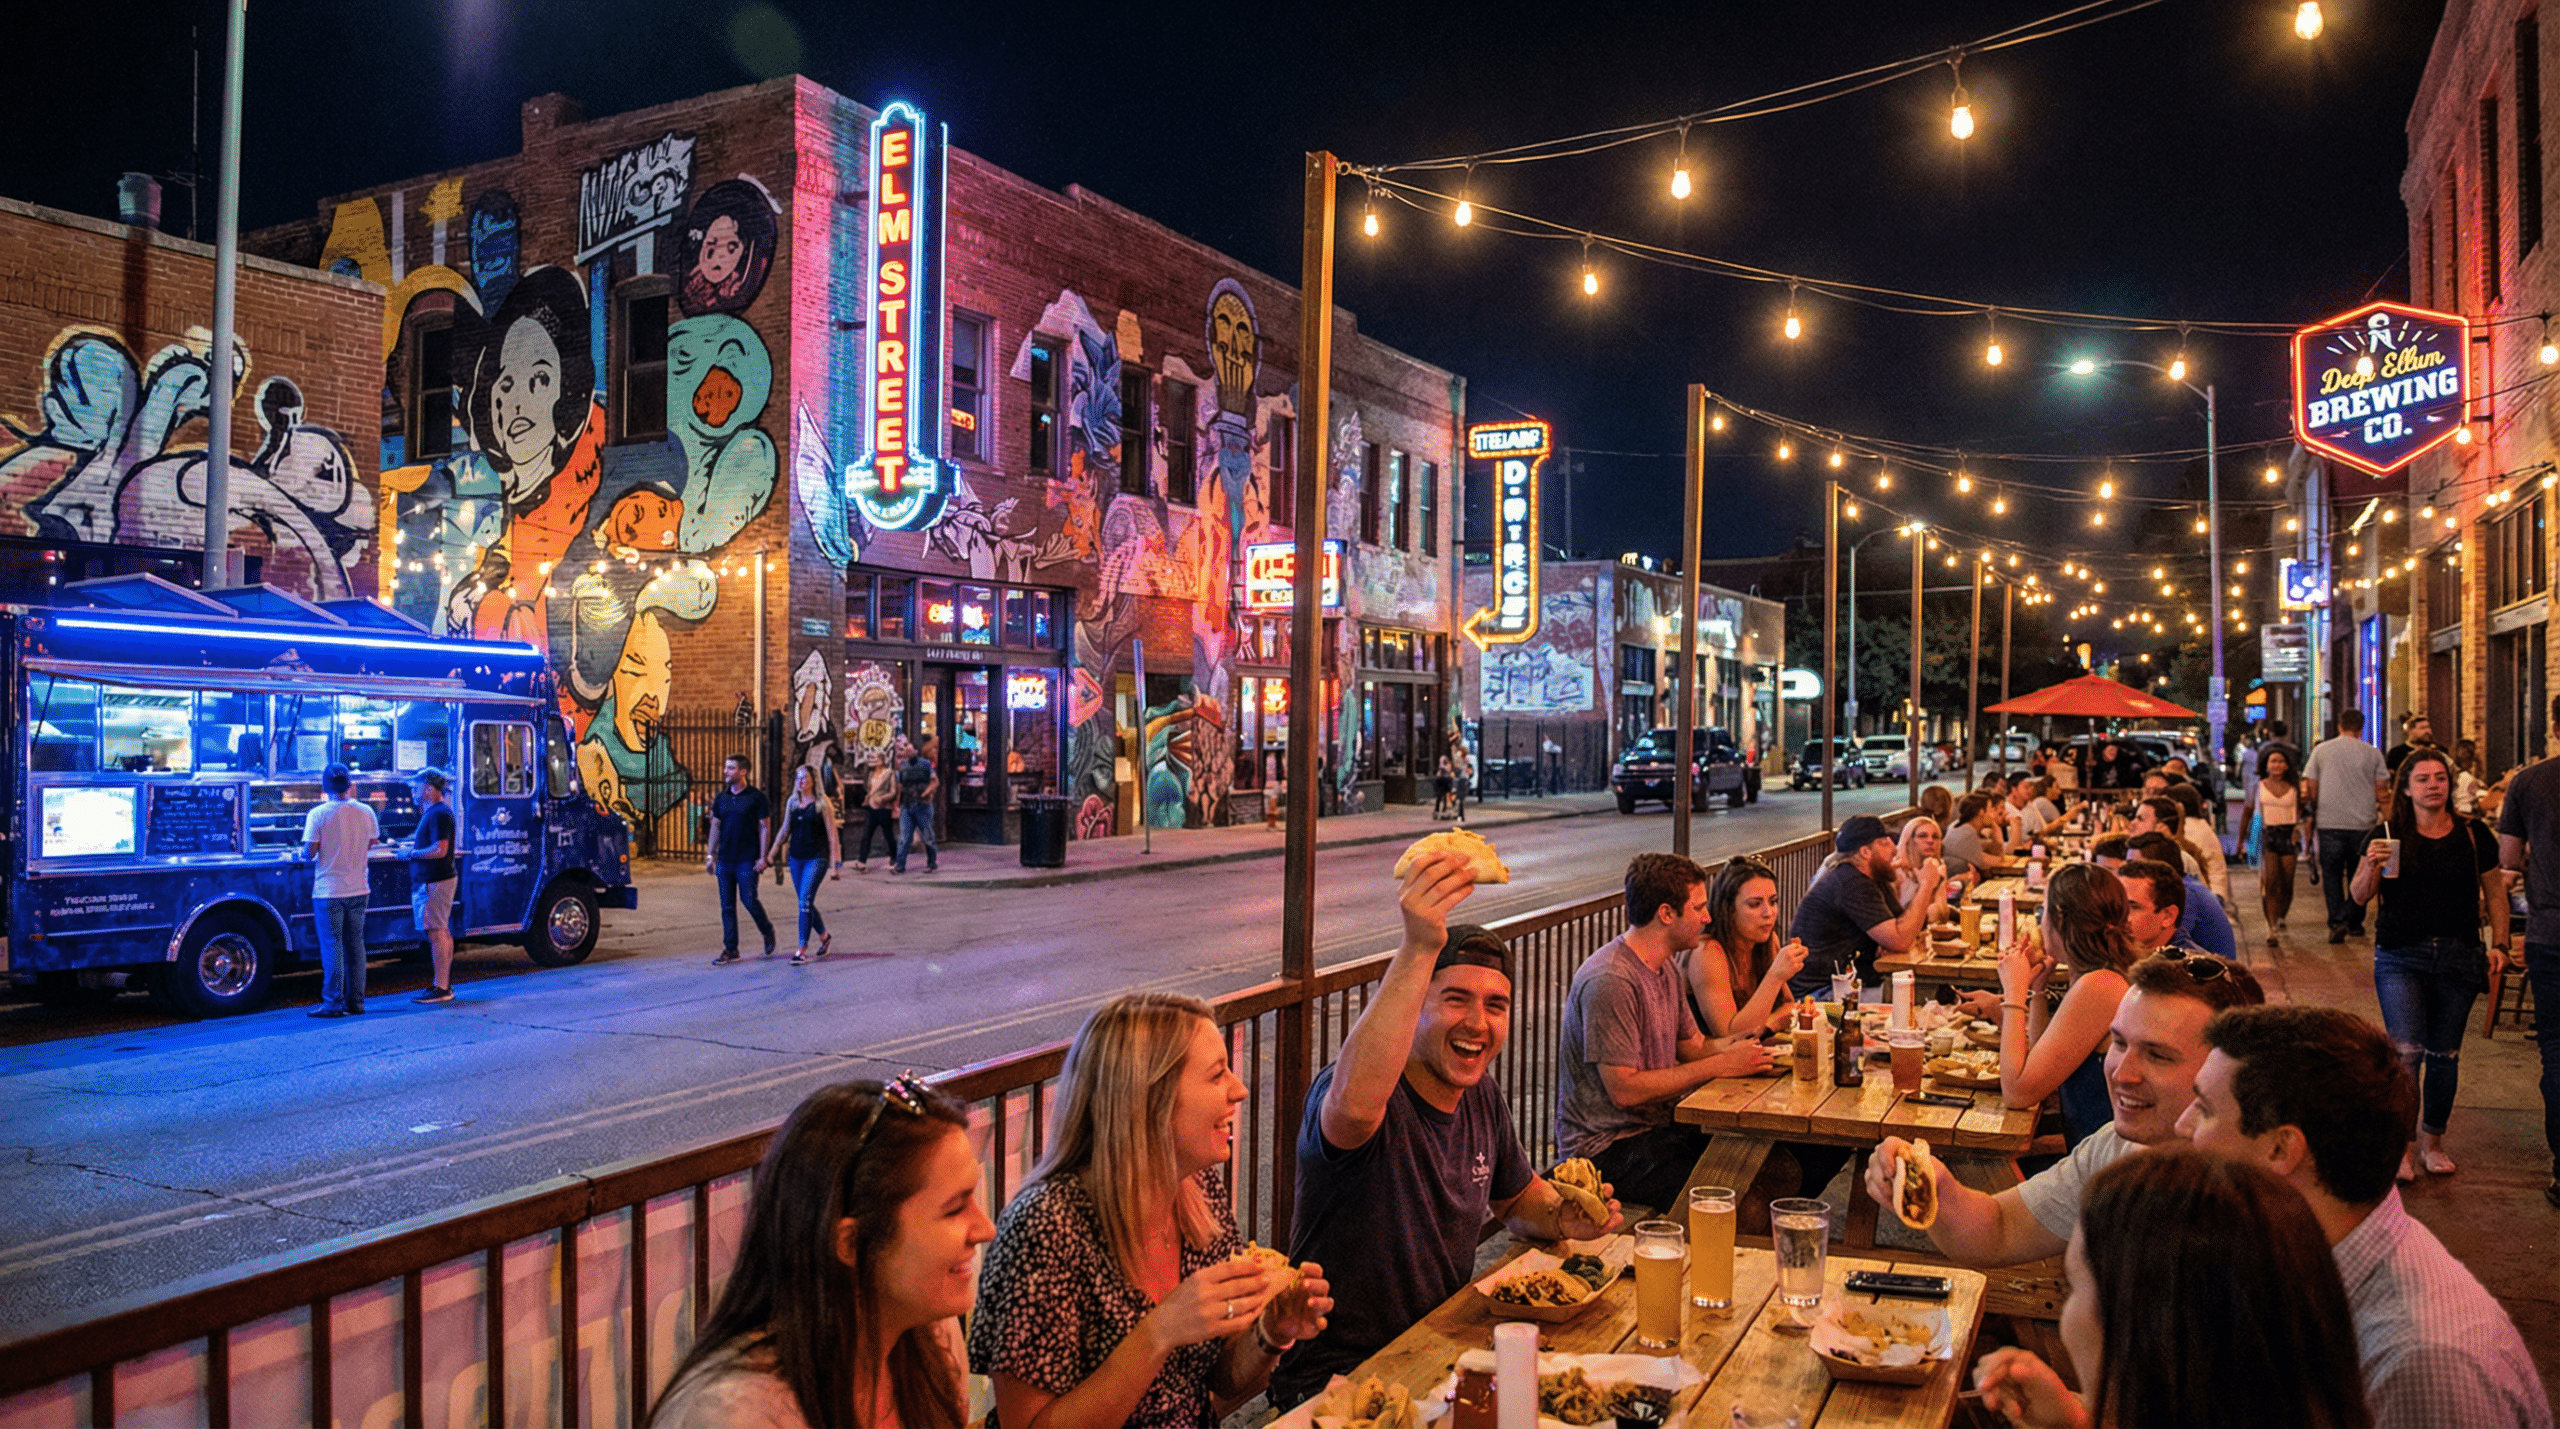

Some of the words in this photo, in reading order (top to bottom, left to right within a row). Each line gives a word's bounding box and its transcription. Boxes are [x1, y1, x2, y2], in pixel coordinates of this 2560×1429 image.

[878, 131, 910, 245] ELM
[876, 260, 907, 491] STREET
[2380, 345, 2446, 378] Ellum
[2308, 366, 2459, 429] BREWING
[2363, 412, 2413, 444] CO.
